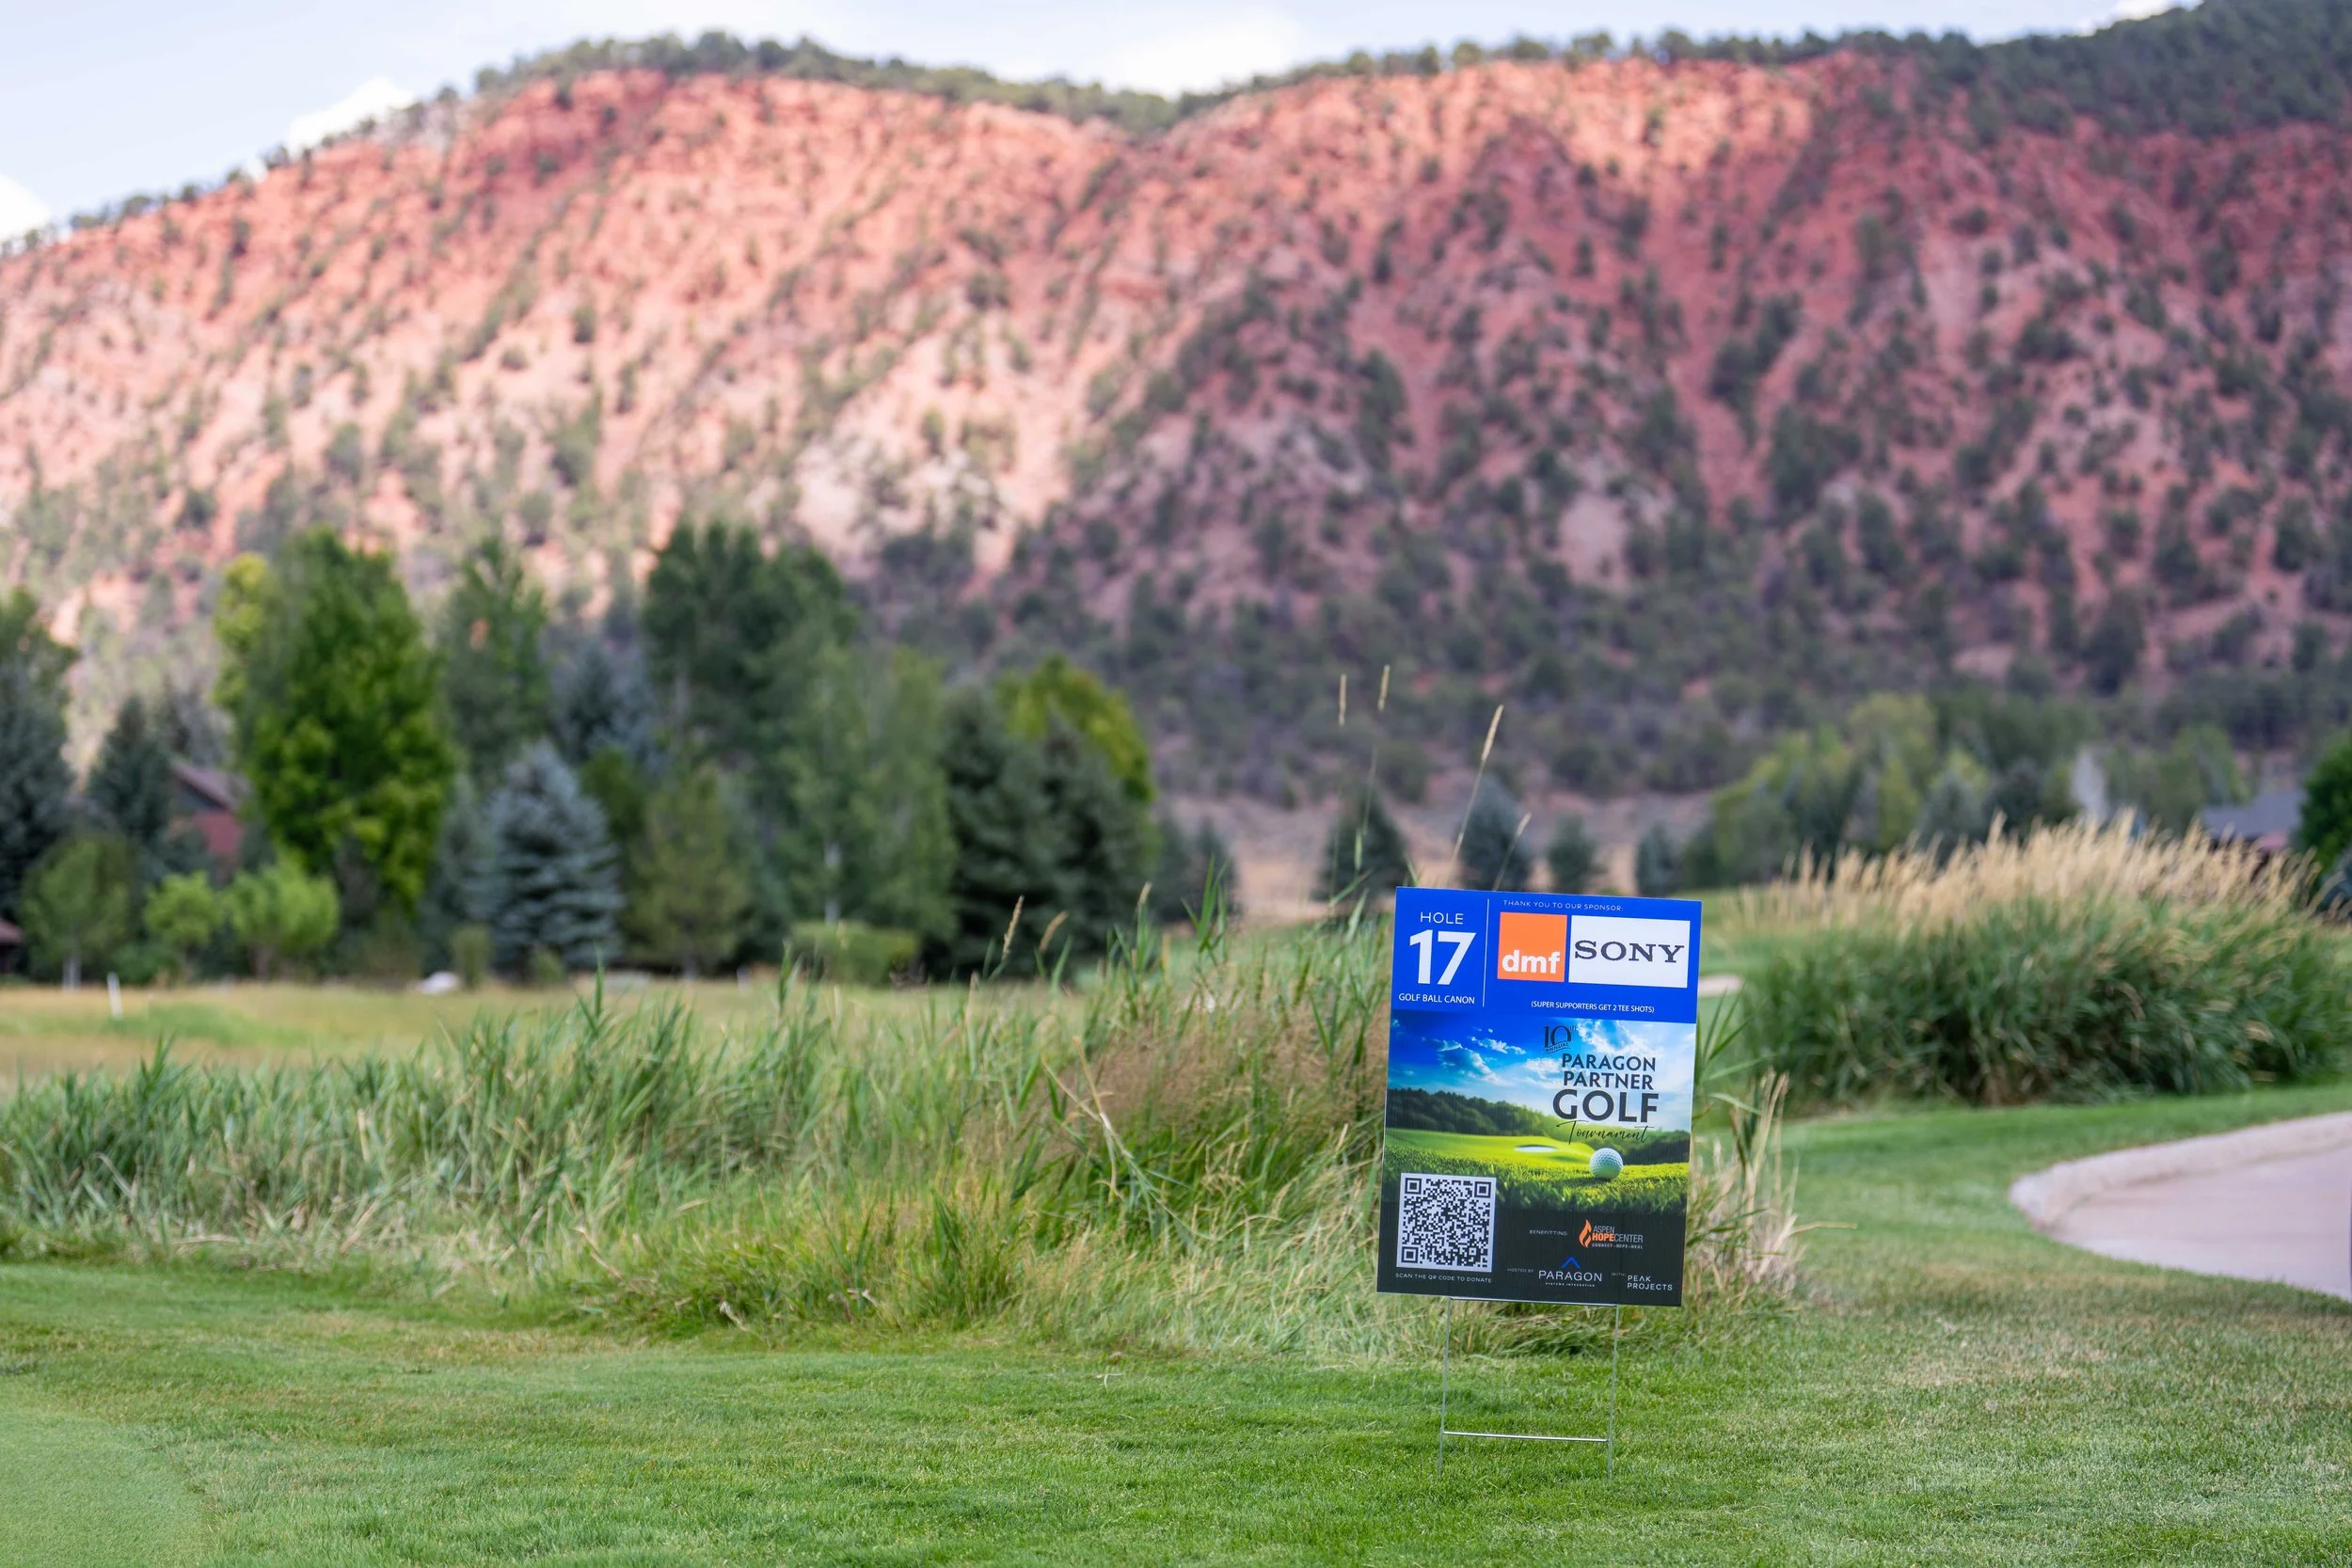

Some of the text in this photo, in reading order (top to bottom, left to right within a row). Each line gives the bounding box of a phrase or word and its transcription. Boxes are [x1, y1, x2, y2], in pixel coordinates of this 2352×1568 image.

[1420, 911, 1464, 925] HOLE
[1409, 929, 1477, 986] 17
[1574, 940, 1685, 963] SONY
[1502, 949, 1560, 974] dmf
[1398, 992, 1475, 1005] GOLF BALL CANON
[1531, 1000, 1554, 1008] (SUPER
[1555, 1002, 1597, 1010] SUPPORTERS
[1630, 1006, 1655, 1014] SHOTS)
[1562, 1053, 1656, 1072] PARAGON
[1564, 1070, 1654, 1090] PARTNER
[1552, 1088, 1660, 1123] GOLF
[1556, 1119, 1656, 1146] Tournament
[1592, 1232, 1644, 1243] HOPECENTER
[1538, 1270, 1603, 1282] PARAGON
[1627, 1282, 1673, 1291] PROJECTS
